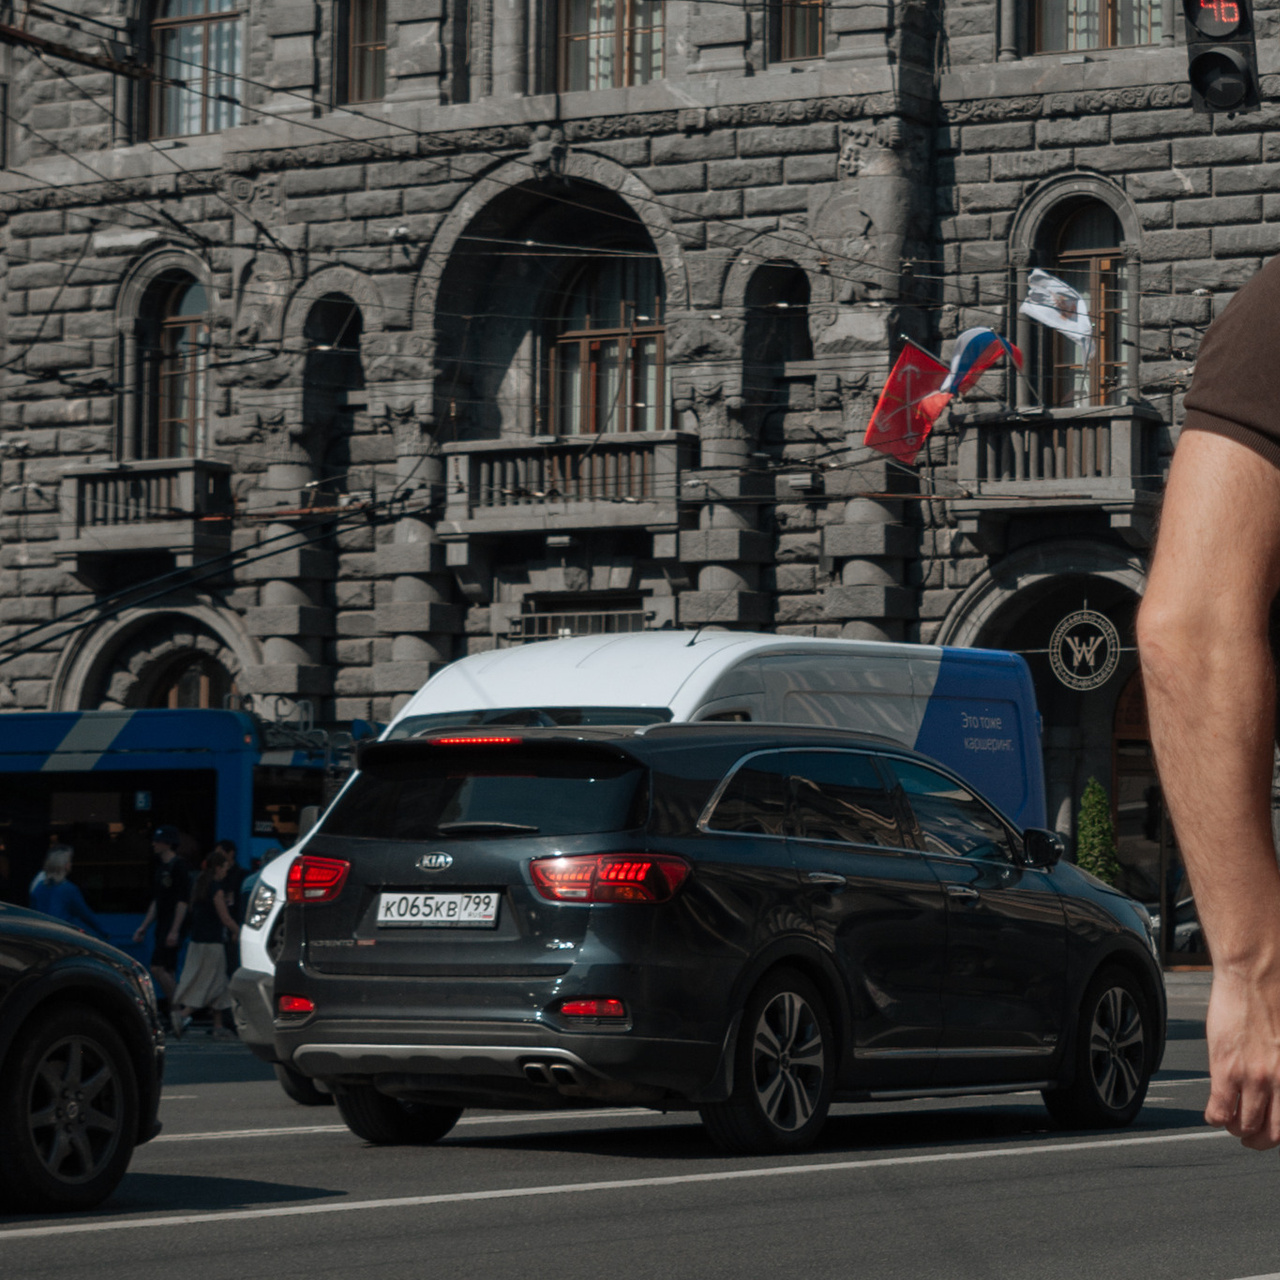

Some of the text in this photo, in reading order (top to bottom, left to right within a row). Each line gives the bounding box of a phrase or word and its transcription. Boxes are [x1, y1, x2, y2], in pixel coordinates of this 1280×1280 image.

[961, 712, 1002, 730] Это тоже
[964, 737, 1014, 753] каршеринг.
[421, 854, 447, 868] KIA
[463, 895, 492, 911] 799
